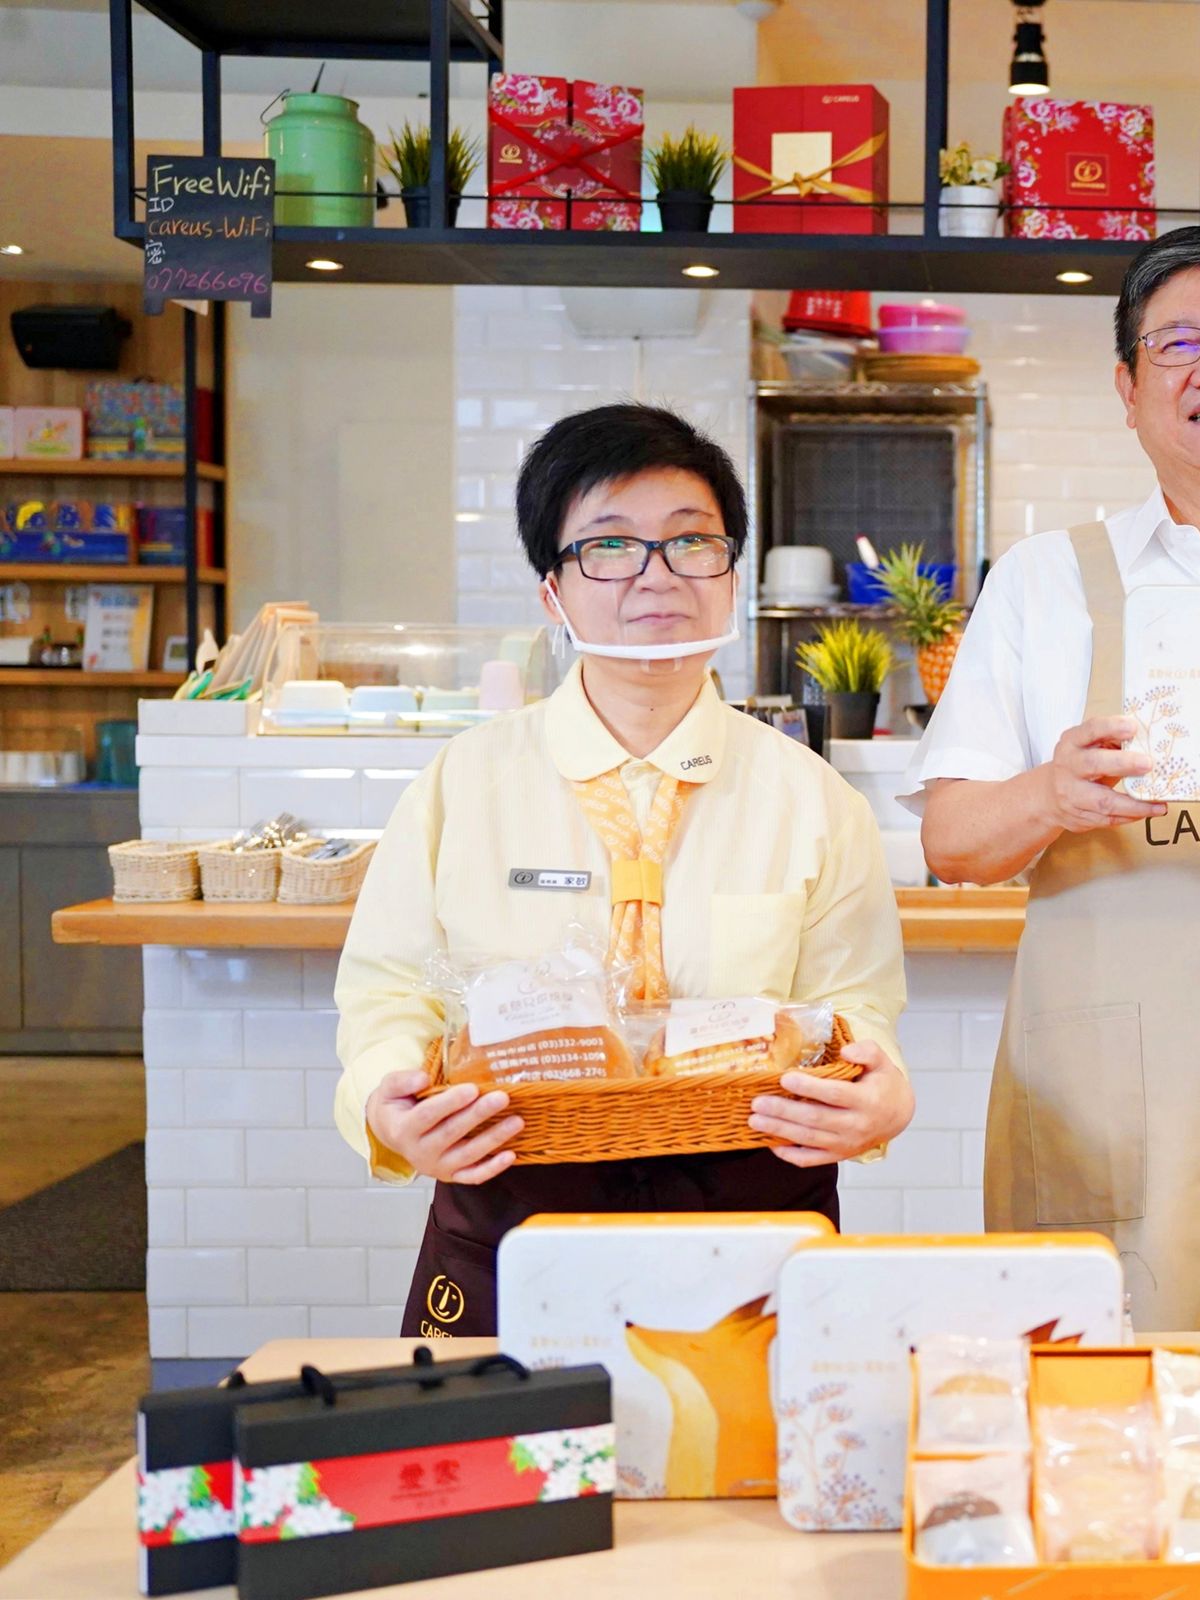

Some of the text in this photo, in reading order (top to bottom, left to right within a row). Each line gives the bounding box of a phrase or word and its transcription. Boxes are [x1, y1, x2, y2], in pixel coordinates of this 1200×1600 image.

[148, 197, 174, 213] ID
[146, 268, 268, 293] 077266096
[680, 754, 713, 771] CAREUS
[420, 1320, 453, 1338] CAR
